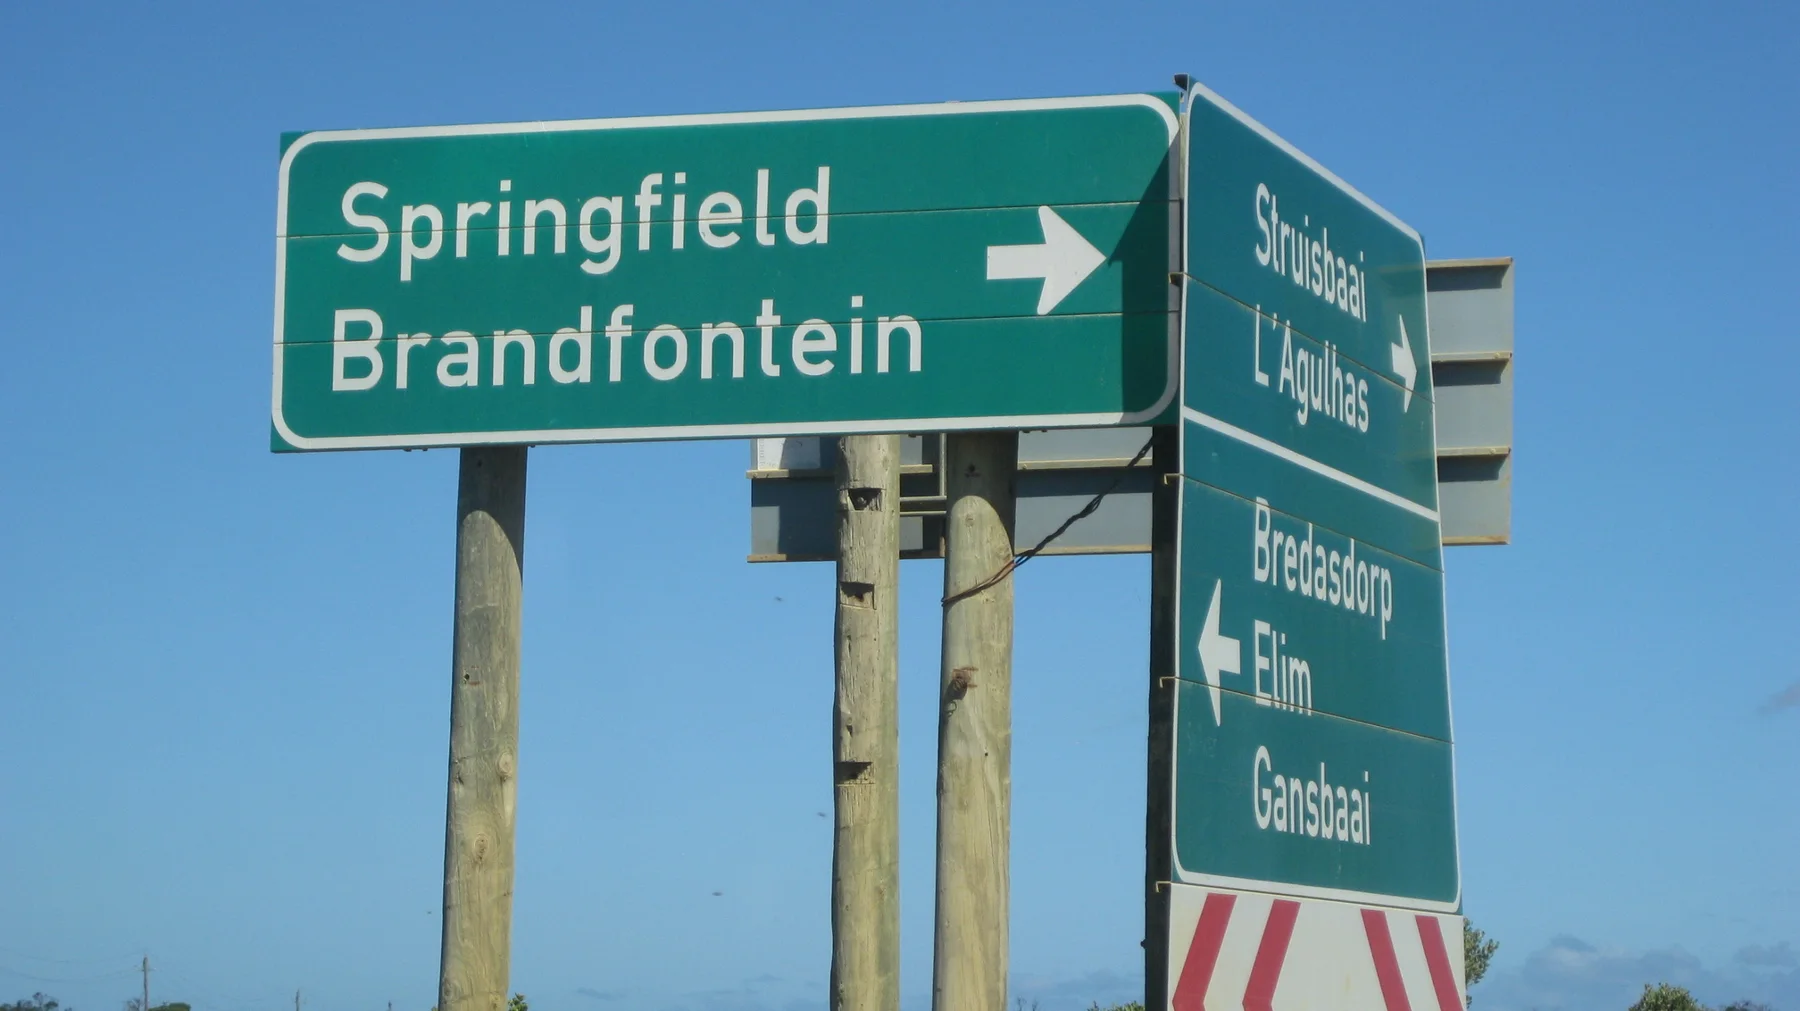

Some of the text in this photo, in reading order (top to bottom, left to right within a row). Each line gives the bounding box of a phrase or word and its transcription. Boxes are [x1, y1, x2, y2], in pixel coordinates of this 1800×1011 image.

[336, 166, 830, 281] Springfield
[1255, 182, 1367, 322] Struisbaai
[332, 296, 922, 391] Brandfontein
[1254, 496, 1393, 640] Bredasdorp
[1253, 619, 1312, 716] Elim
[1253, 745, 1371, 845] Gansbaai
